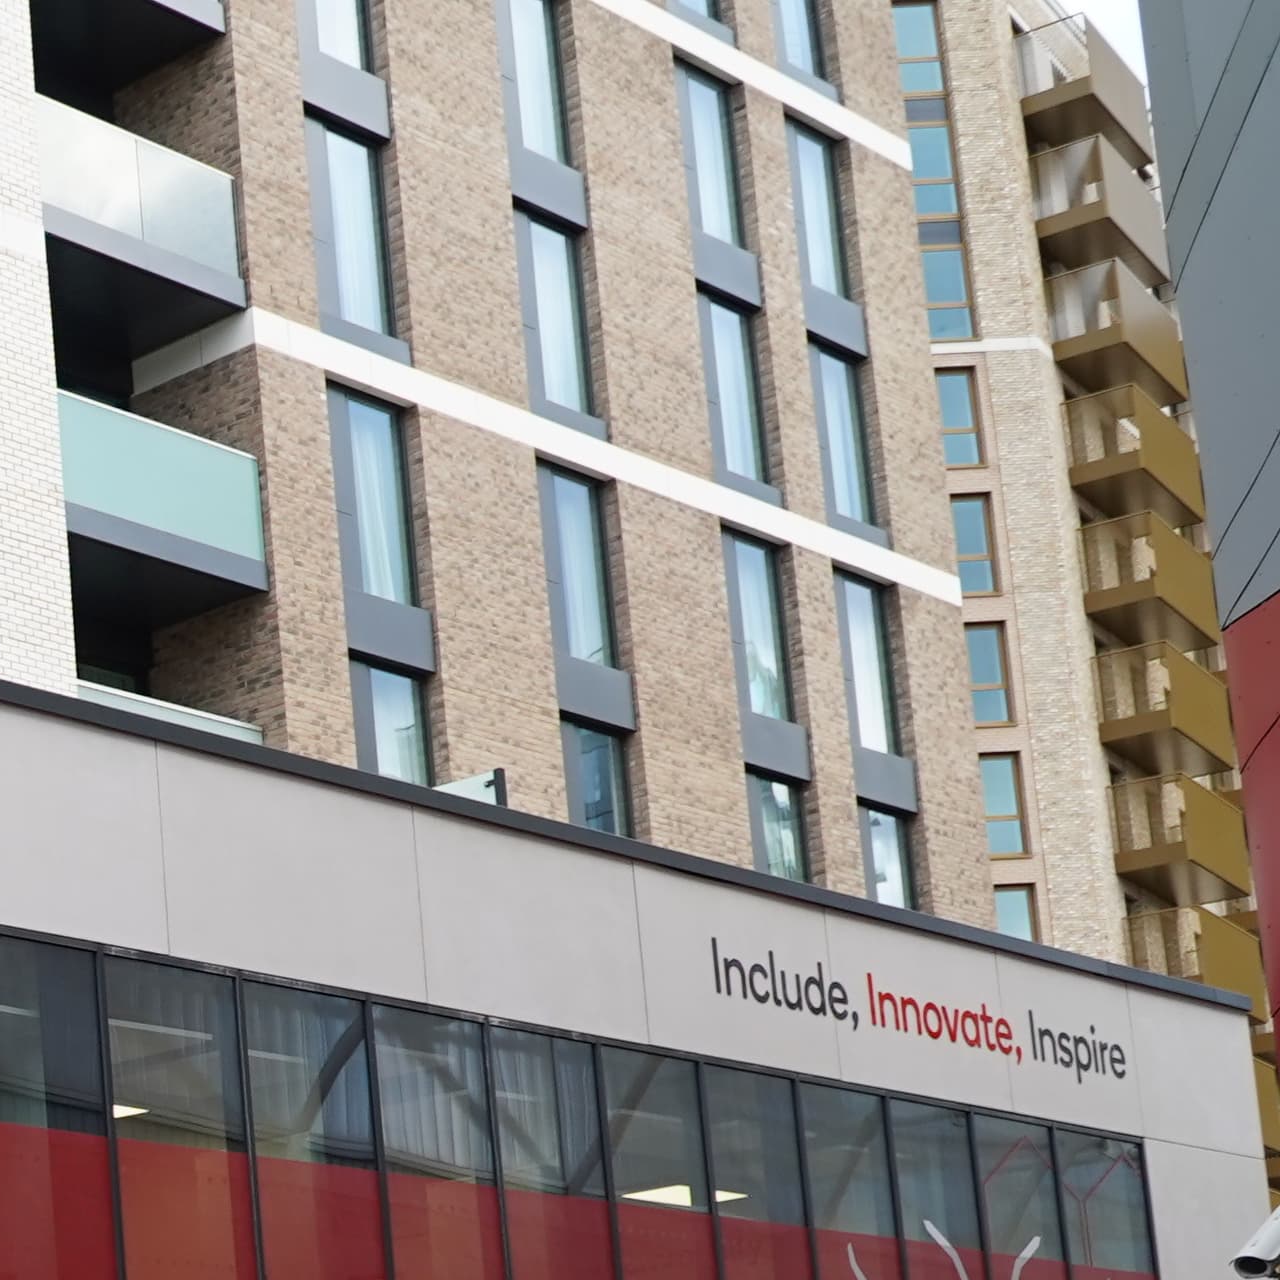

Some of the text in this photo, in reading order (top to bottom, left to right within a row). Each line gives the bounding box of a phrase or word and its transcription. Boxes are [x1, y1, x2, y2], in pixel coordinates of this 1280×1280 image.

[710, 936, 1127, 1084] Include, Innovate, Inspire
